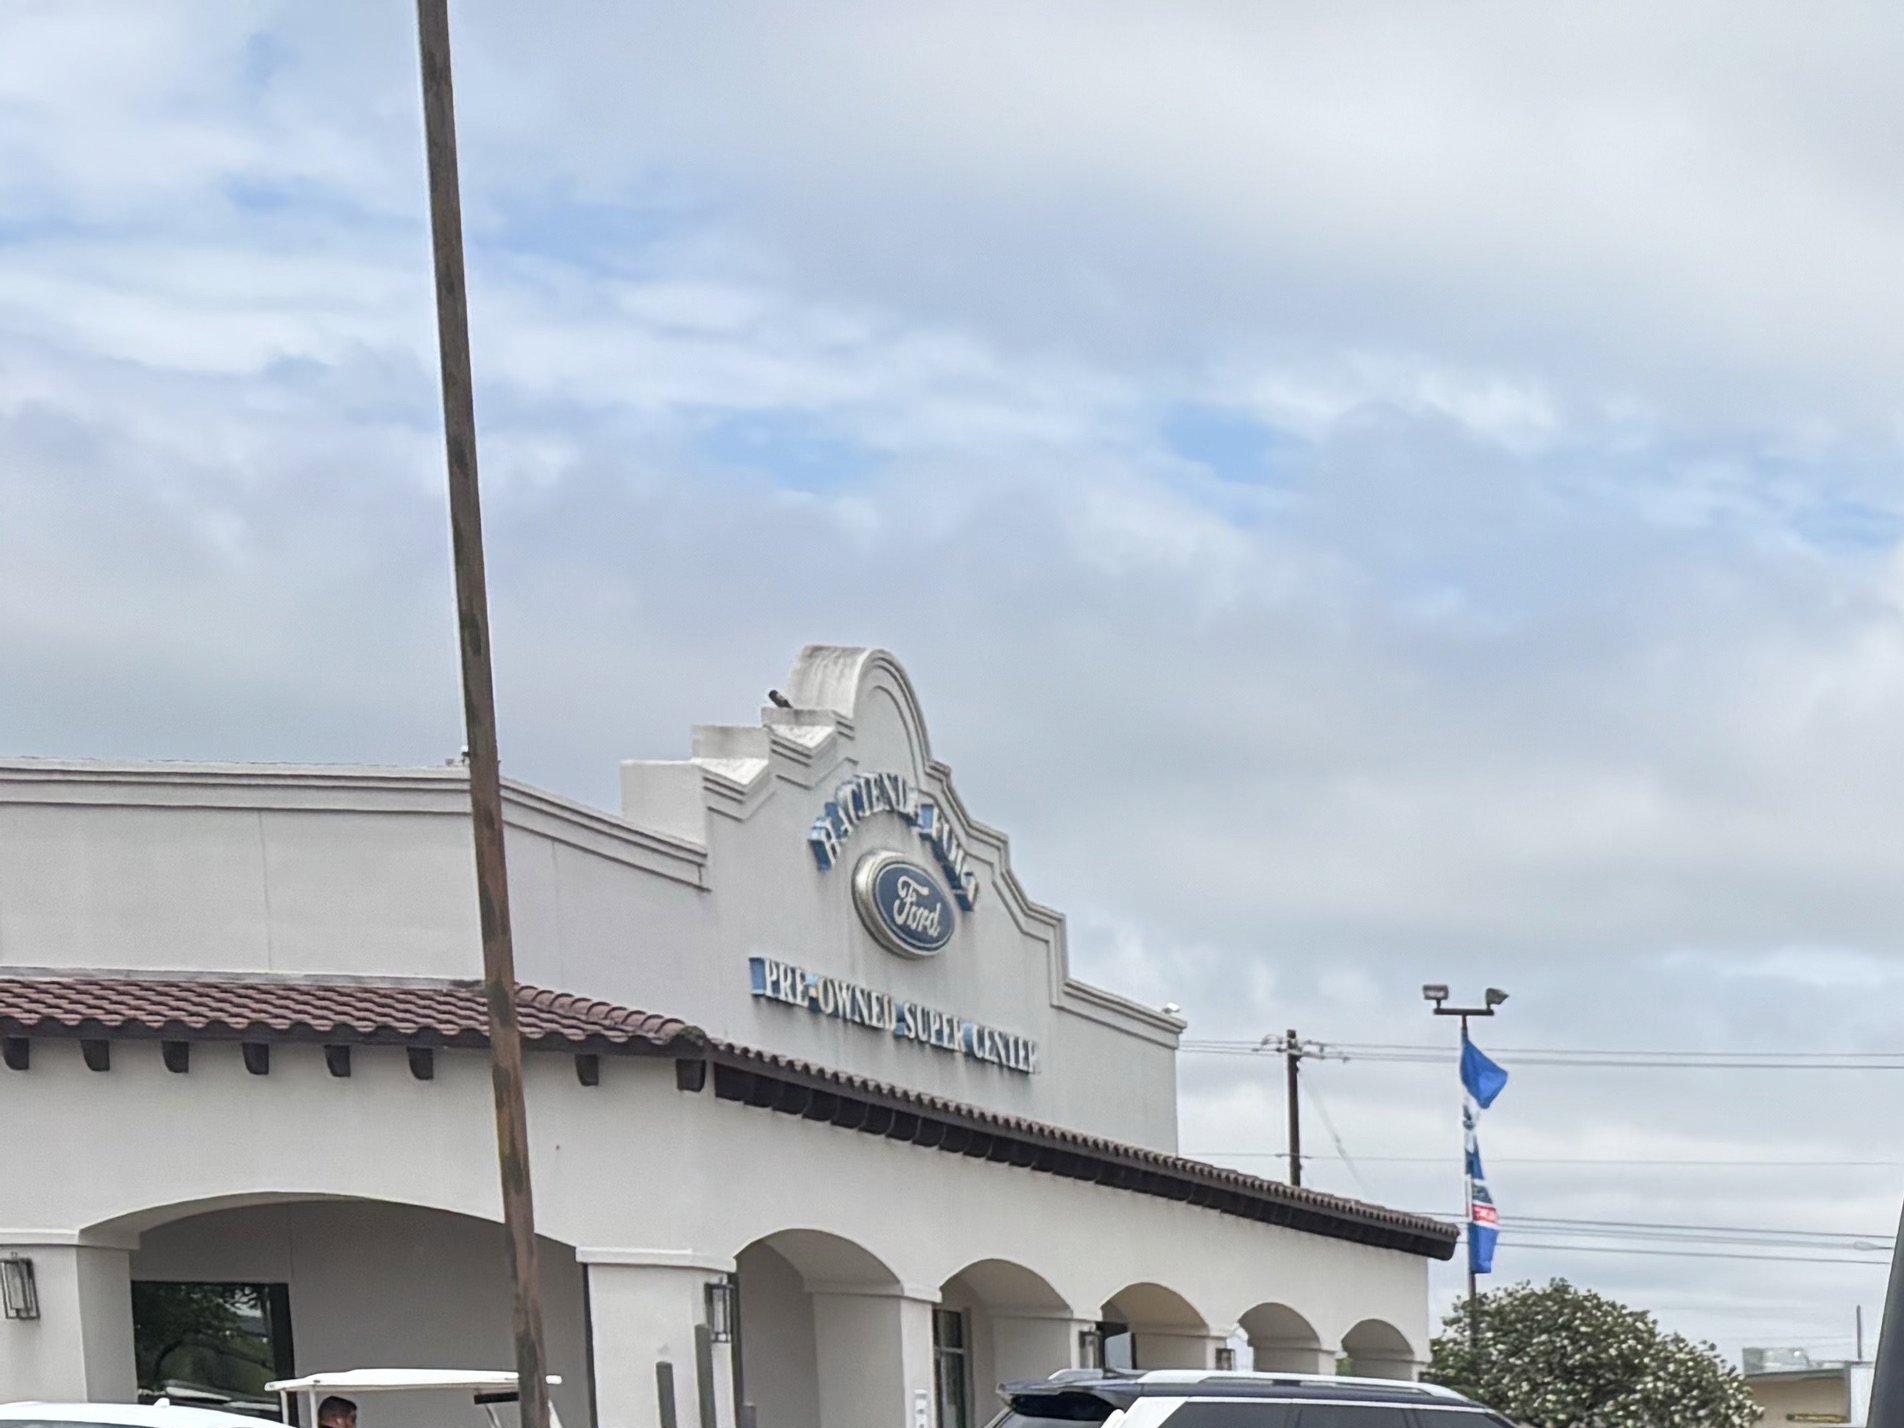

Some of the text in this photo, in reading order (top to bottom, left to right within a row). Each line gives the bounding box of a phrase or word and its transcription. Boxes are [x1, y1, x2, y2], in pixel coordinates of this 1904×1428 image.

[893, 876, 941, 937] Ford
[757, 958, 1038, 1074] PRE-OWNED SUPER CENTER
